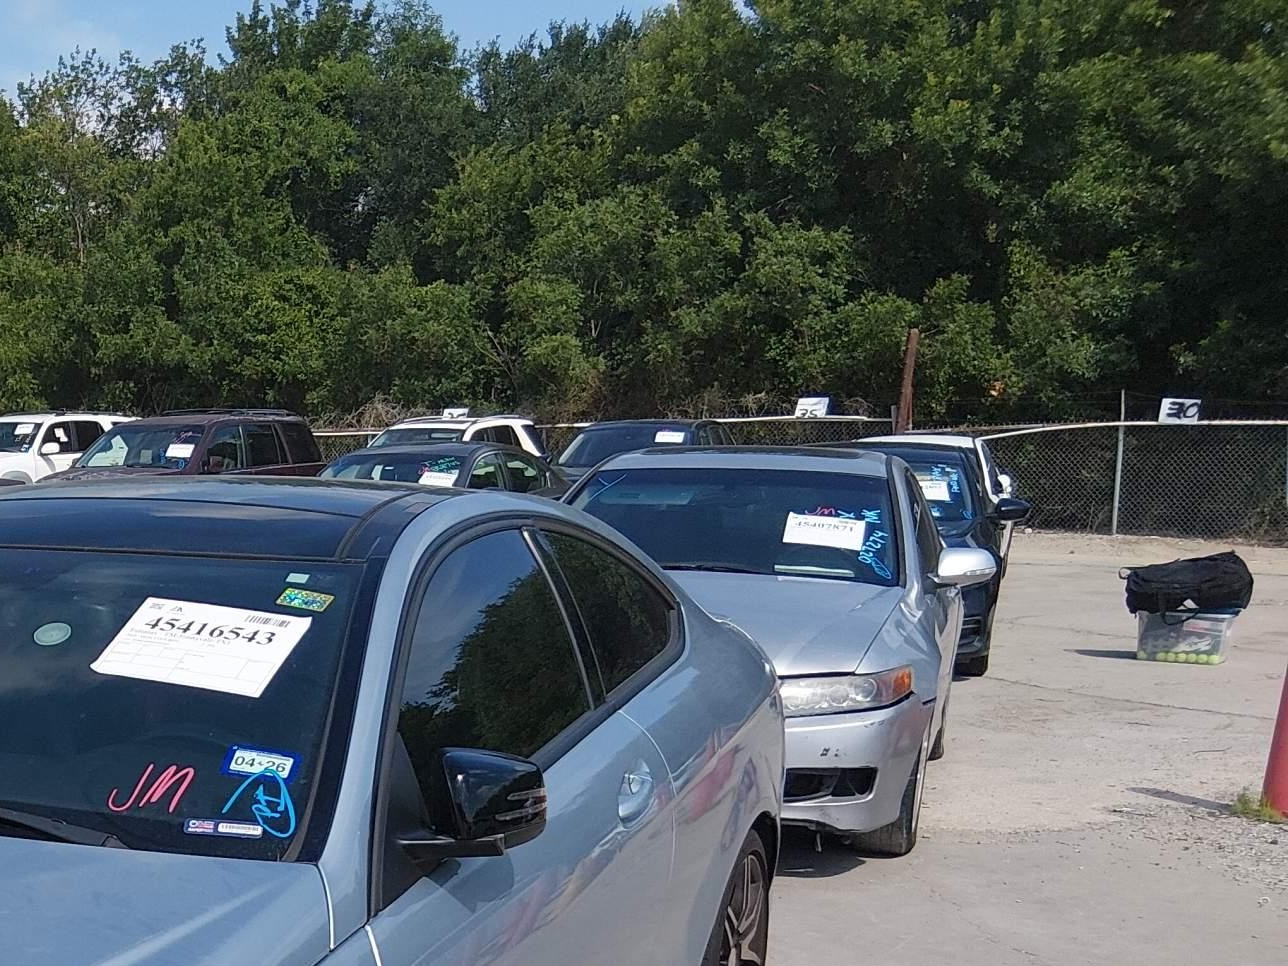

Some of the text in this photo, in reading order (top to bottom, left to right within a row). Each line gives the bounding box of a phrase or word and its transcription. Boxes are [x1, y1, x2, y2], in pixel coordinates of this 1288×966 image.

[1166, 401, 1201, 420] 30
[145, 615, 277, 646] 45416543
[107, 762, 196, 814] JM
